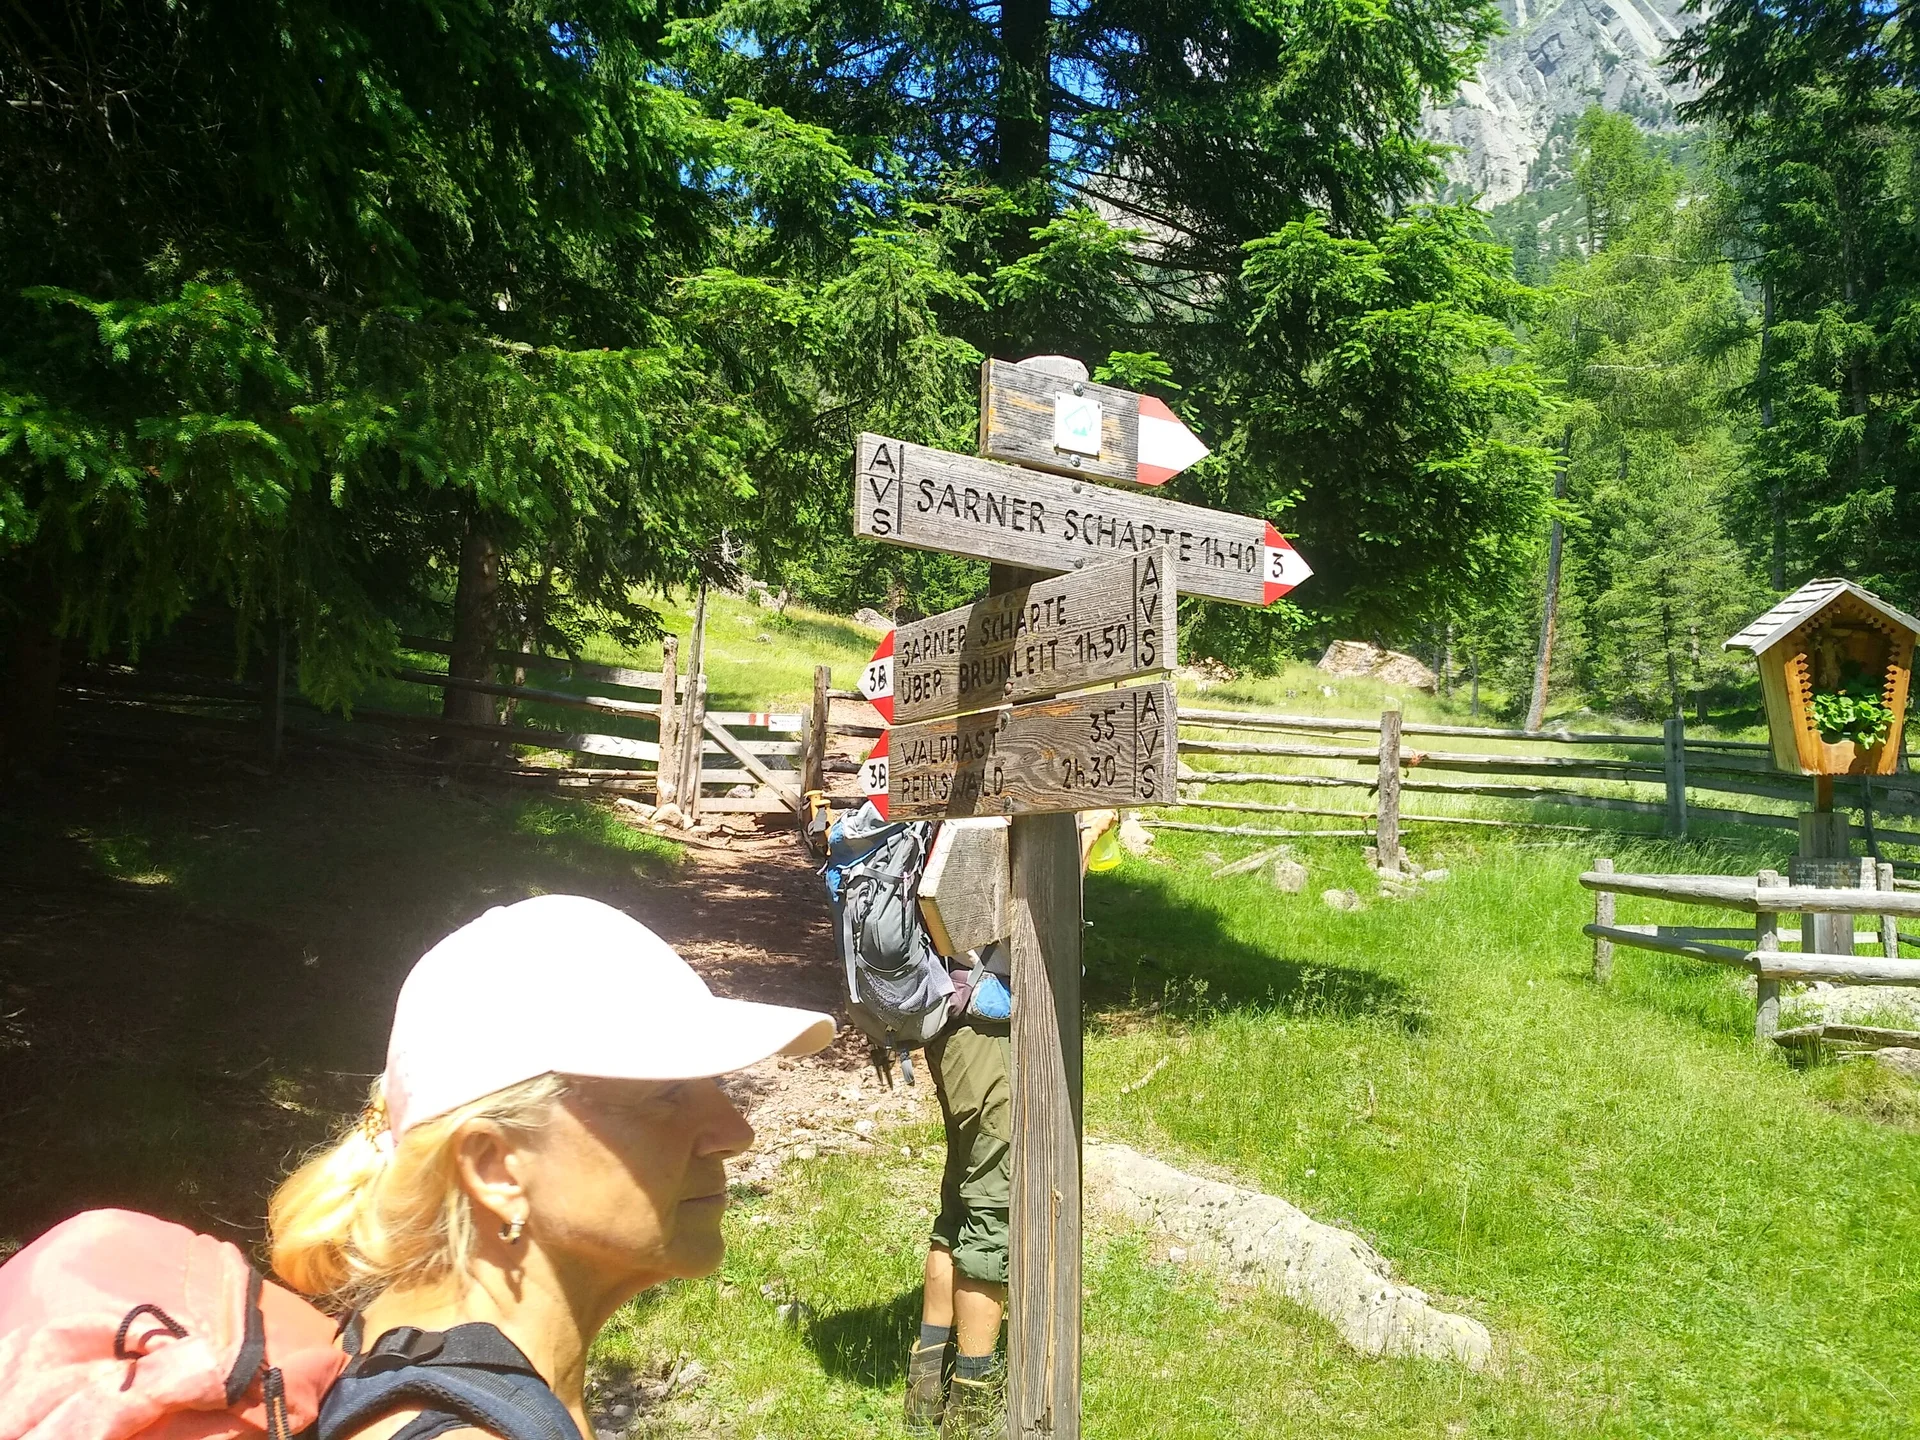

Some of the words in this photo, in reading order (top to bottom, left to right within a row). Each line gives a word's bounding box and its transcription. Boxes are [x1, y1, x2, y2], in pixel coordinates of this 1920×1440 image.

[868, 442, 896, 536] AVS
[916, 478, 1046, 535] SARNER
[1063, 508, 1193, 562] SCHARTE
[1271, 551, 1285, 578] 3
[1139, 555, 1160, 667] AVS
[901, 624, 968, 668] SARNER
[979, 595, 1067, 647] SCHARTE
[868, 664, 888, 693] 3B
[901, 668, 943, 705] ÜBER
[900, 727, 1000, 766] WALDRAST
[1139, 690, 1160, 799] AVS
[868, 762, 887, 789] 3B
[901, 765, 1004, 803] REINSWALD
